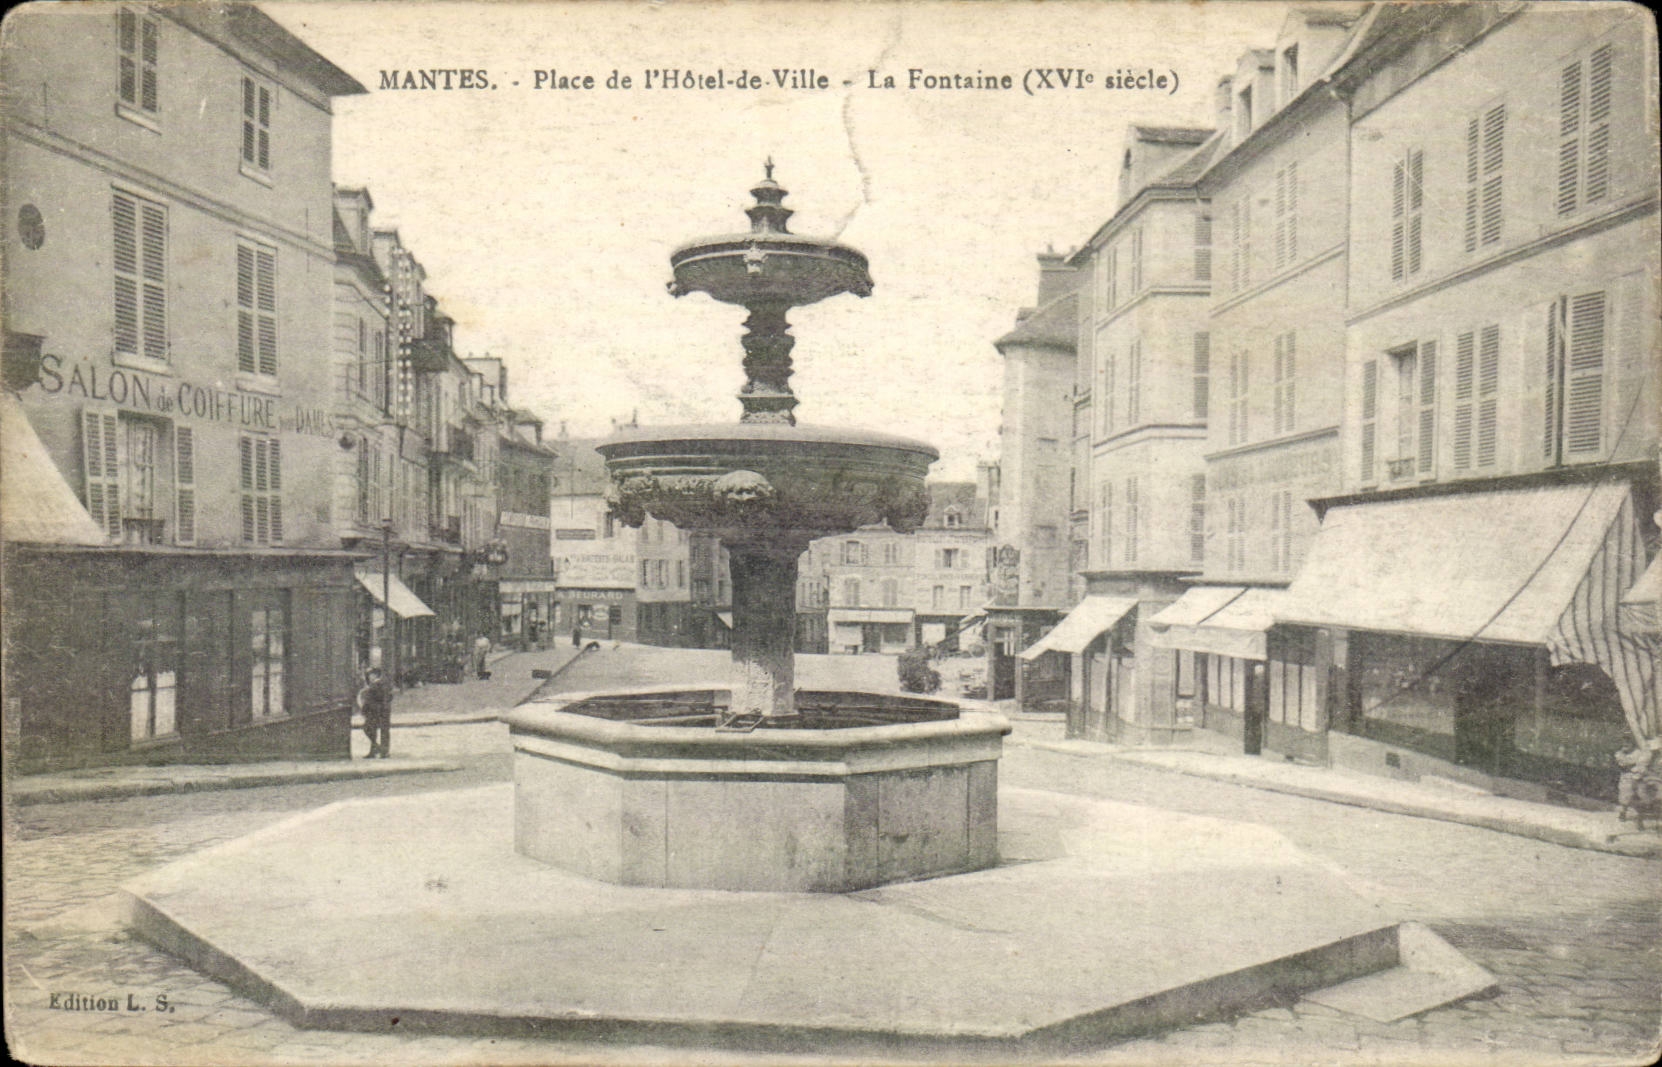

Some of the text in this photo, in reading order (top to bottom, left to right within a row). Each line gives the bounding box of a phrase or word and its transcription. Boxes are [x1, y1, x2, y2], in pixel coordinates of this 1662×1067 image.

[39, 353, 150, 409] SALON
[156, 385, 174, 413] de
[178, 382, 277, 430] COIFFURE
